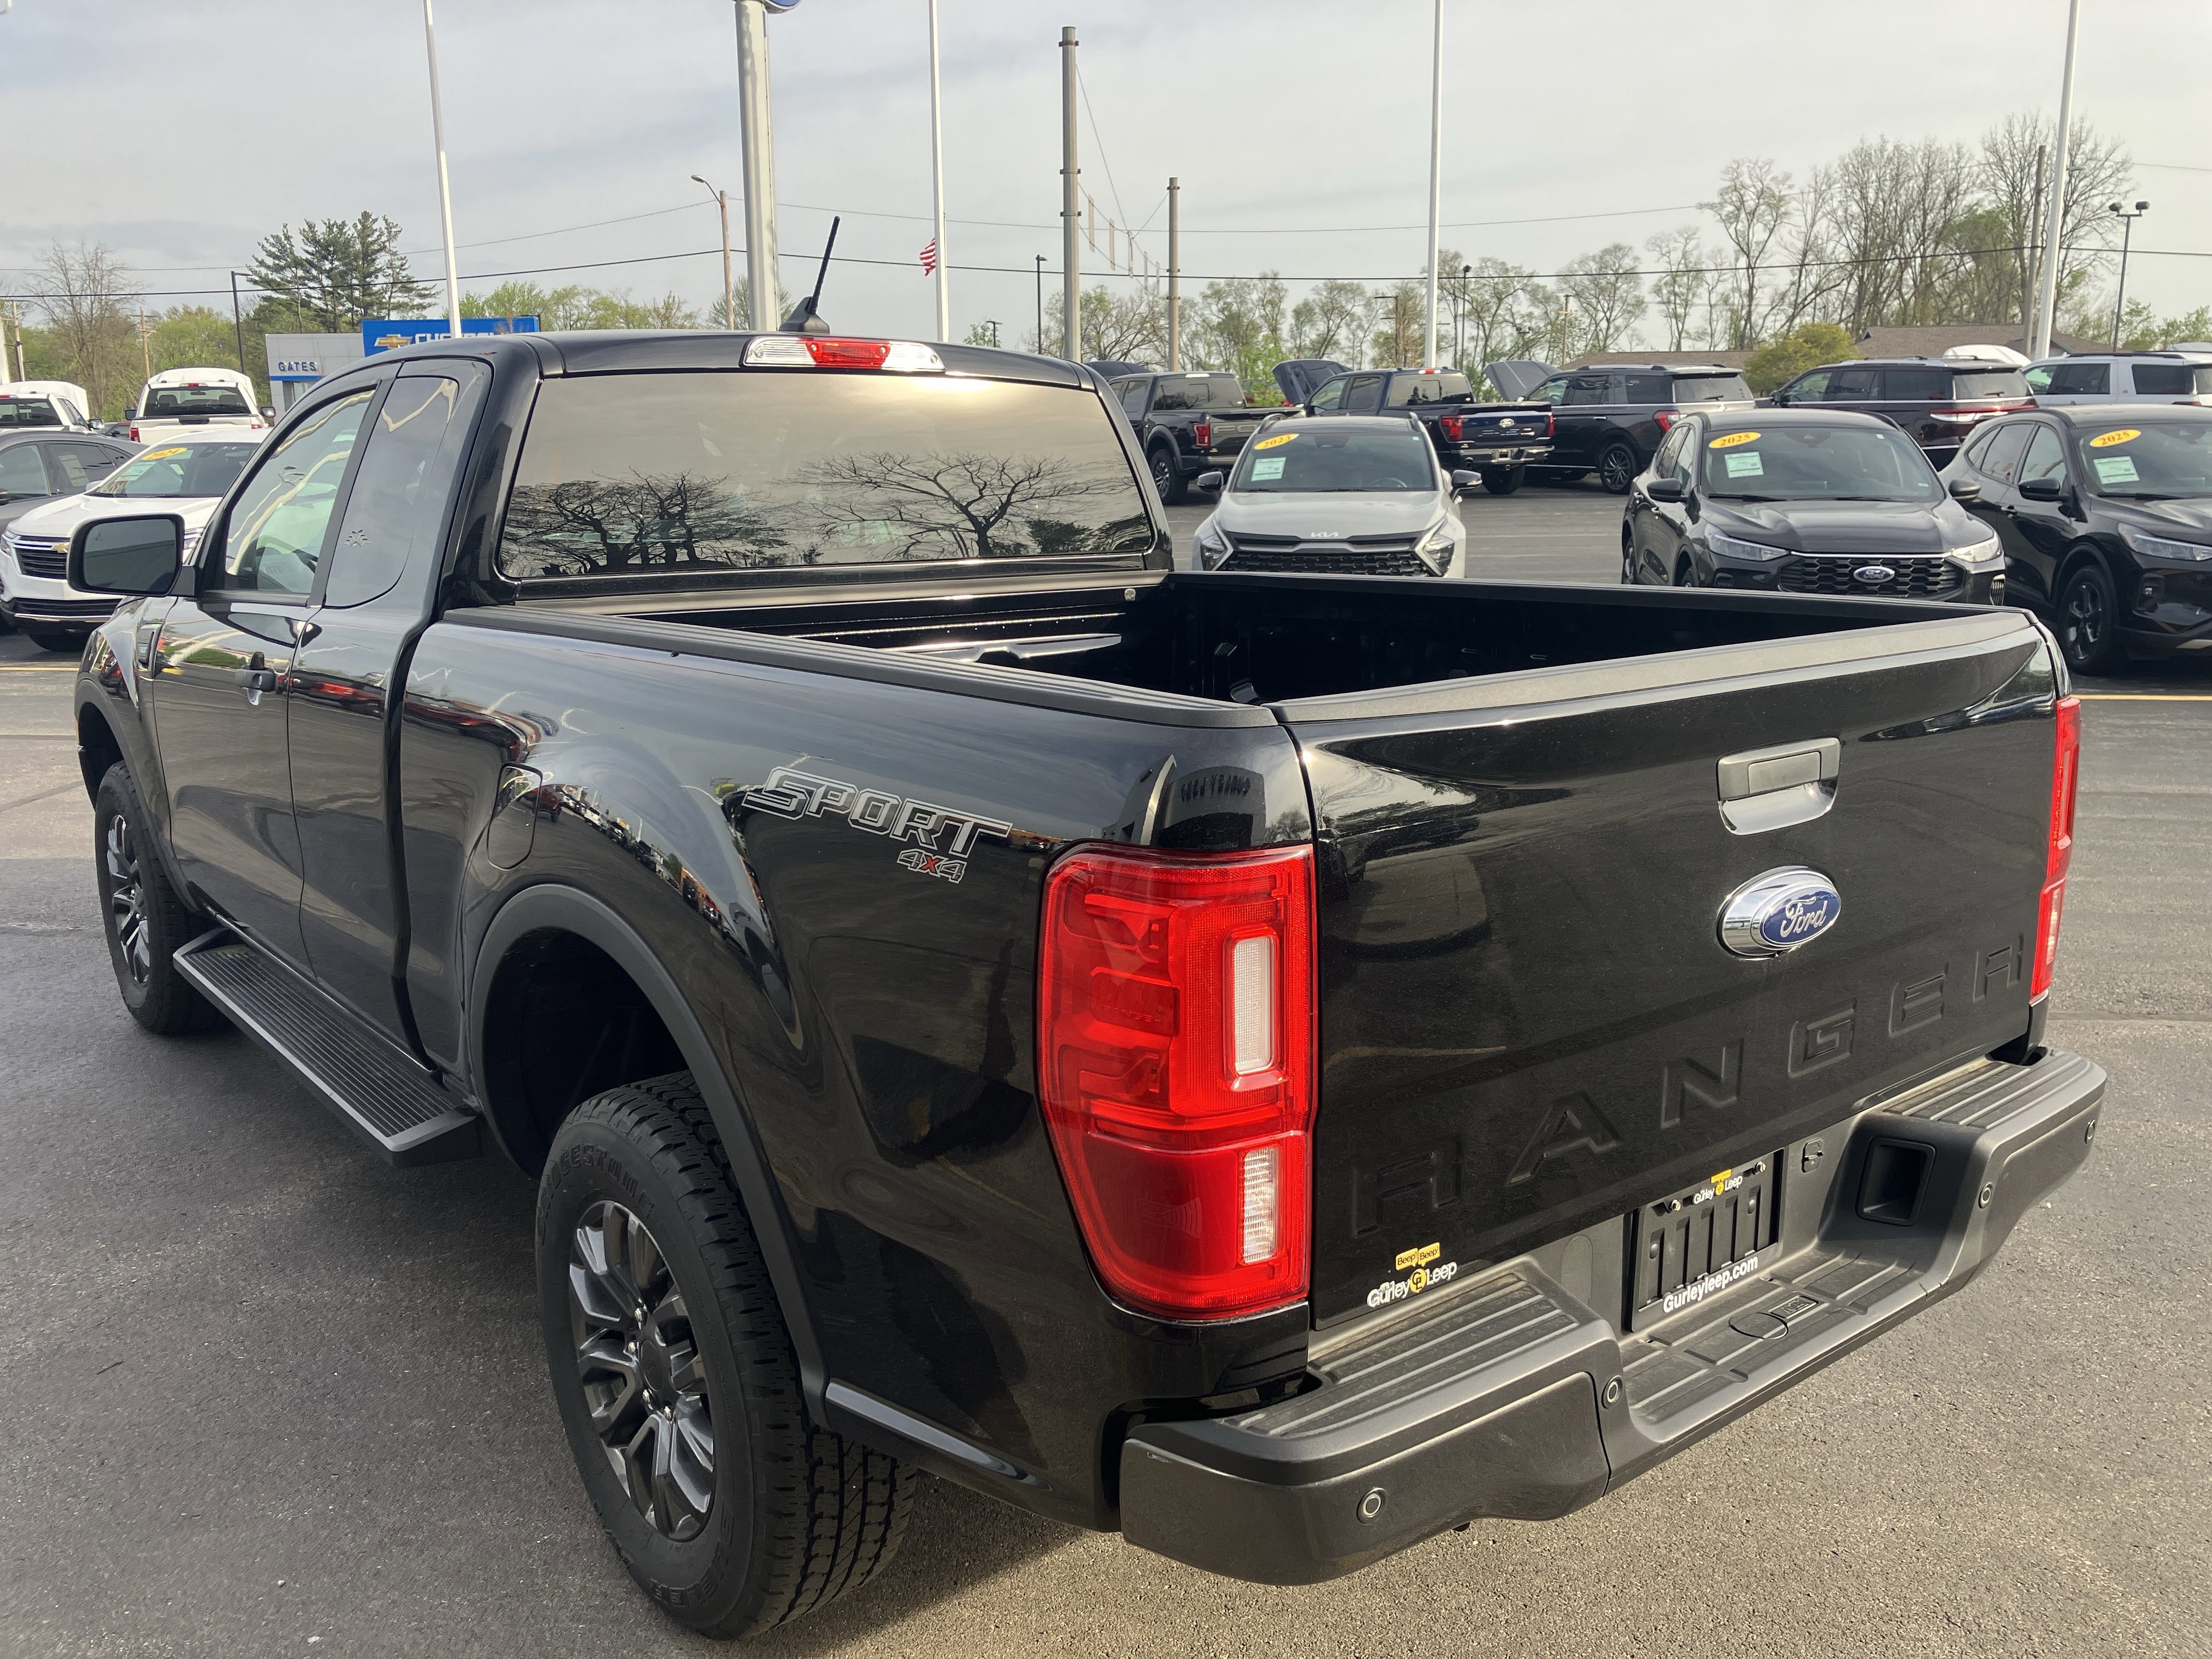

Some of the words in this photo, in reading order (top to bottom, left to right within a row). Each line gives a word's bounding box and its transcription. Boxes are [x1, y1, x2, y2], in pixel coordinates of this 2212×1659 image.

[278, 362, 317, 372] GATES
[1720, 433, 1750, 447] 2025
[2101, 431, 2130, 445] 2025
[741, 766, 1014, 858] SPORT
[1780, 896, 1827, 938] Ford
[1351, 934, 2025, 1239] RANGER
[1724, 1175, 1743, 1191] Leep
[1397, 1251, 1418, 1266] Beep!
[1420, 1245, 1440, 1260] Beep!
[1367, 1279, 1410, 1308] Gurley
[1425, 1261, 1458, 1285] Leep
[1663, 1256, 1758, 1313] Gurleyleep.com
